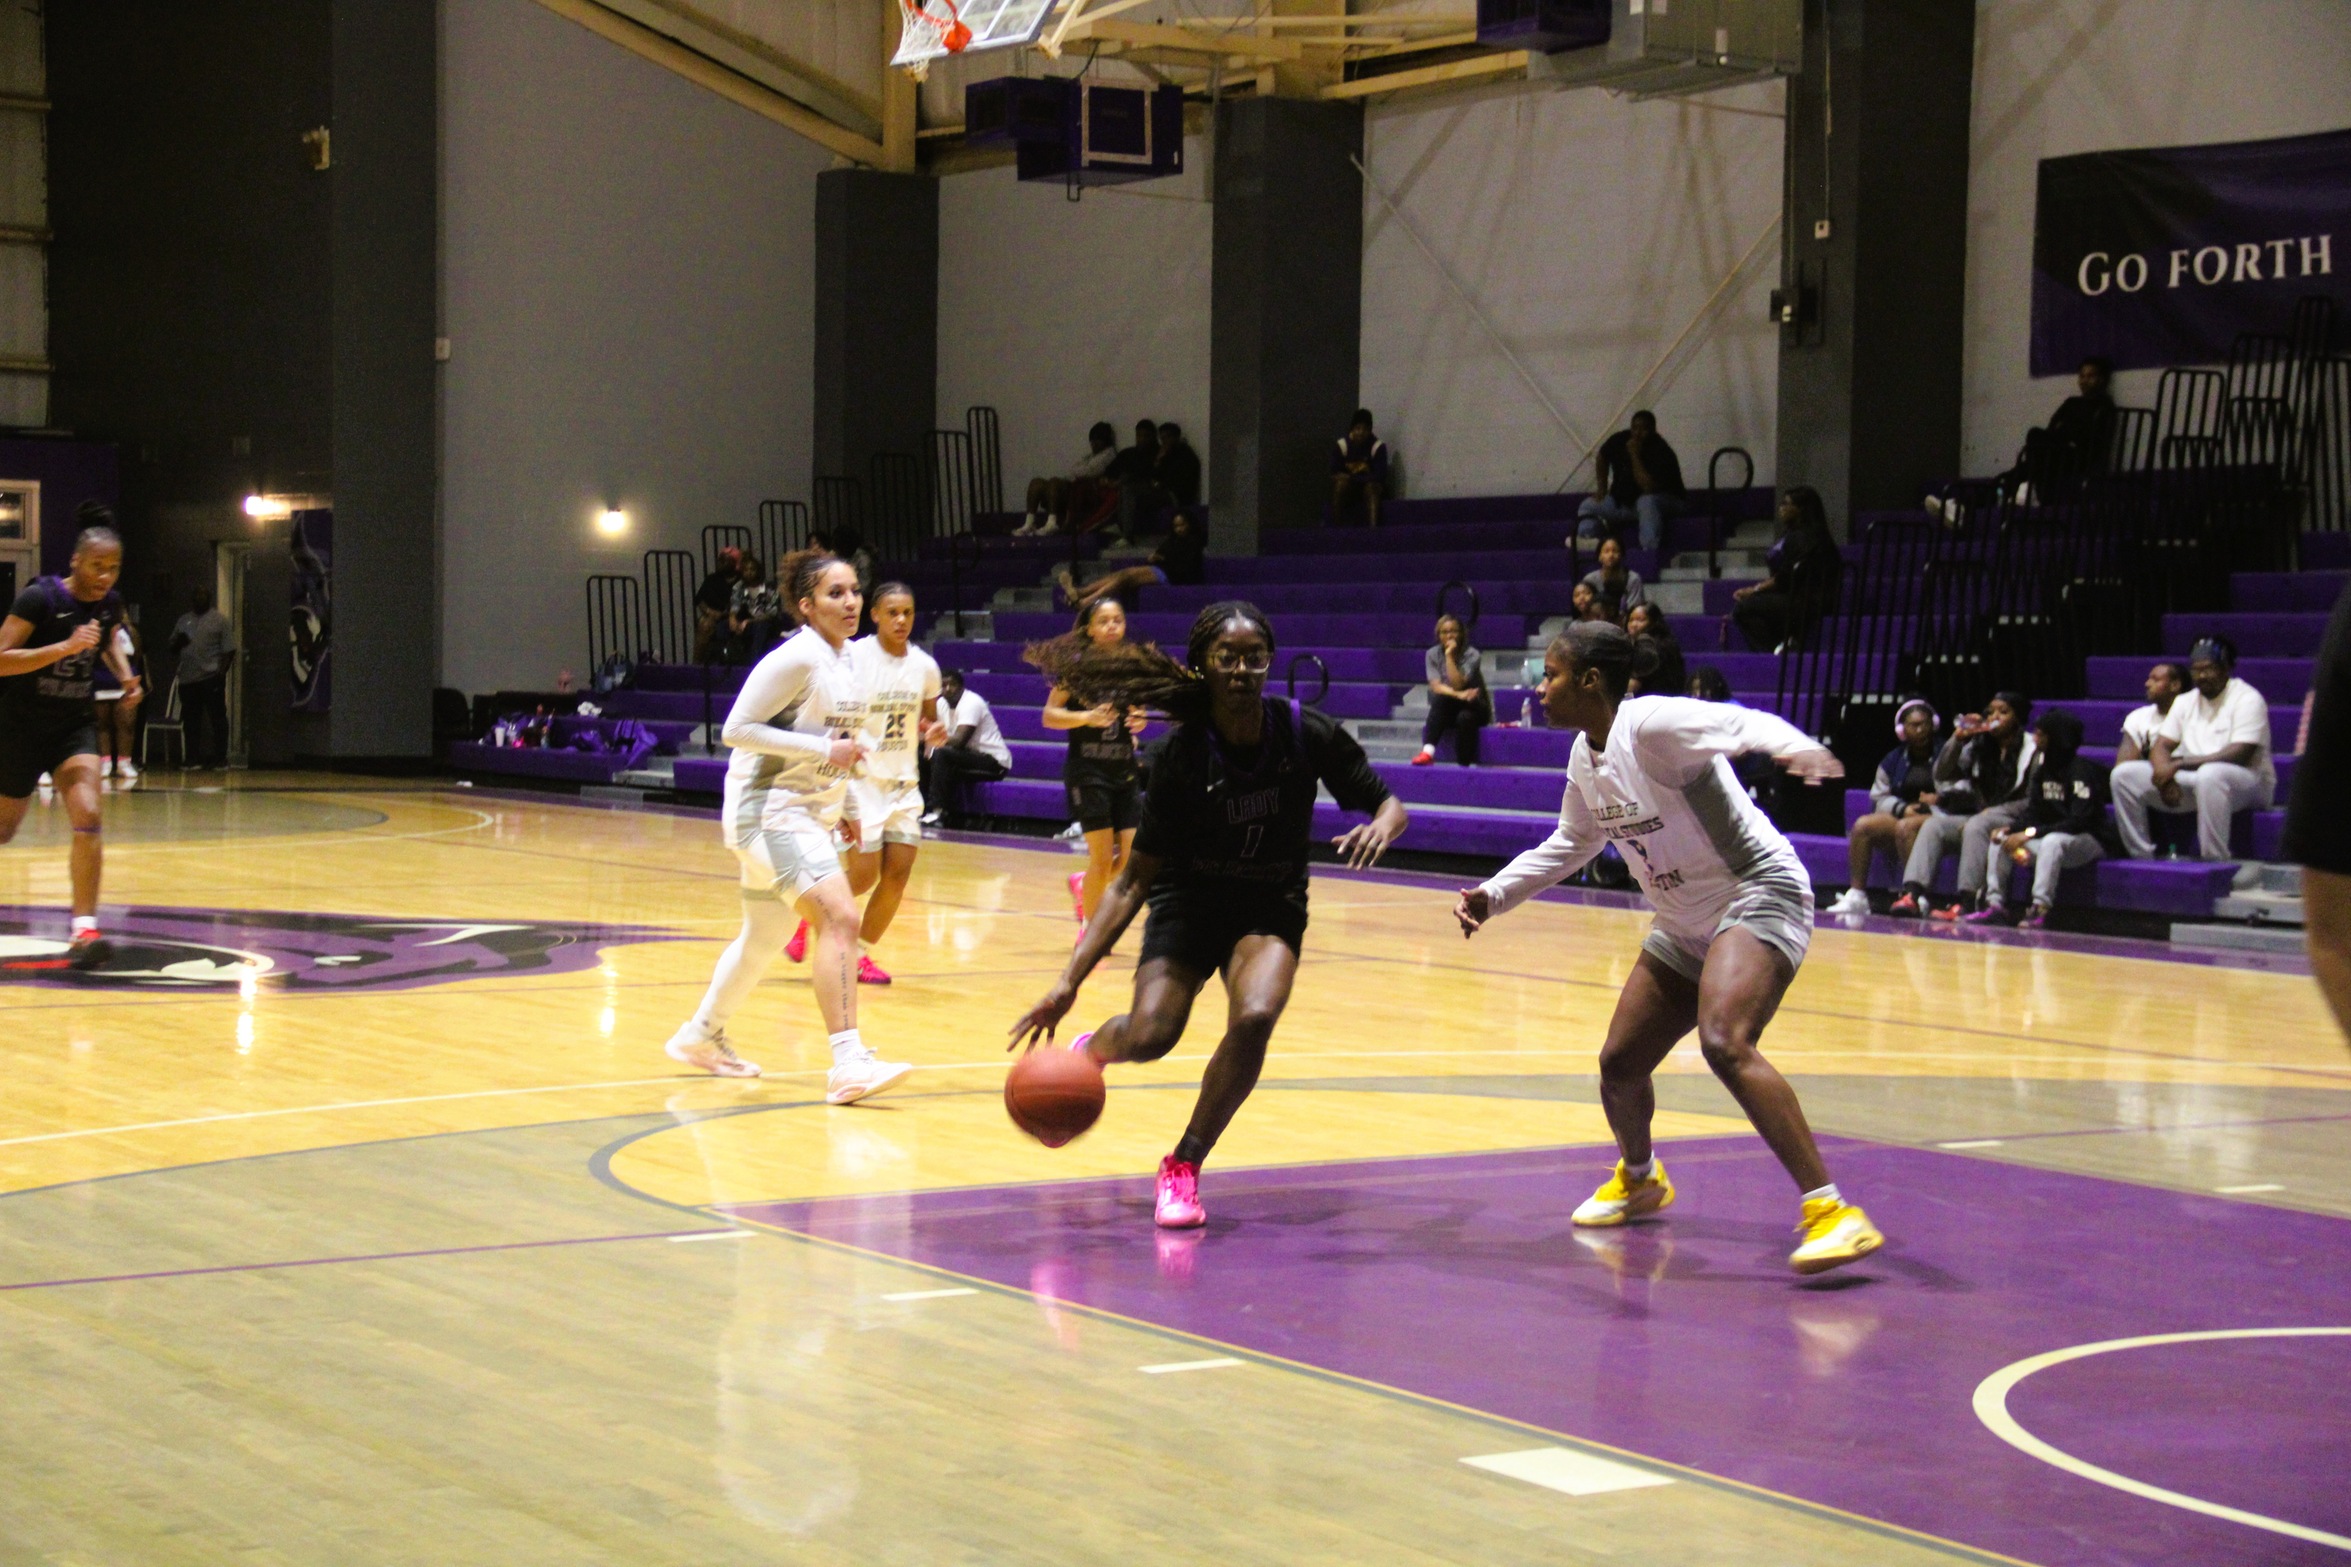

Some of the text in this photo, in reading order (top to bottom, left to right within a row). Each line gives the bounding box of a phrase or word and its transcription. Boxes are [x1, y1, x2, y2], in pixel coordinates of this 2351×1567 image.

[2078, 234, 2332, 296] GO FORTH
[884, 713, 907, 739] 25
[1227, 786, 1280, 825] LADY
[1625, 802, 1639, 817] OF
[1240, 824, 1264, 858] 1
